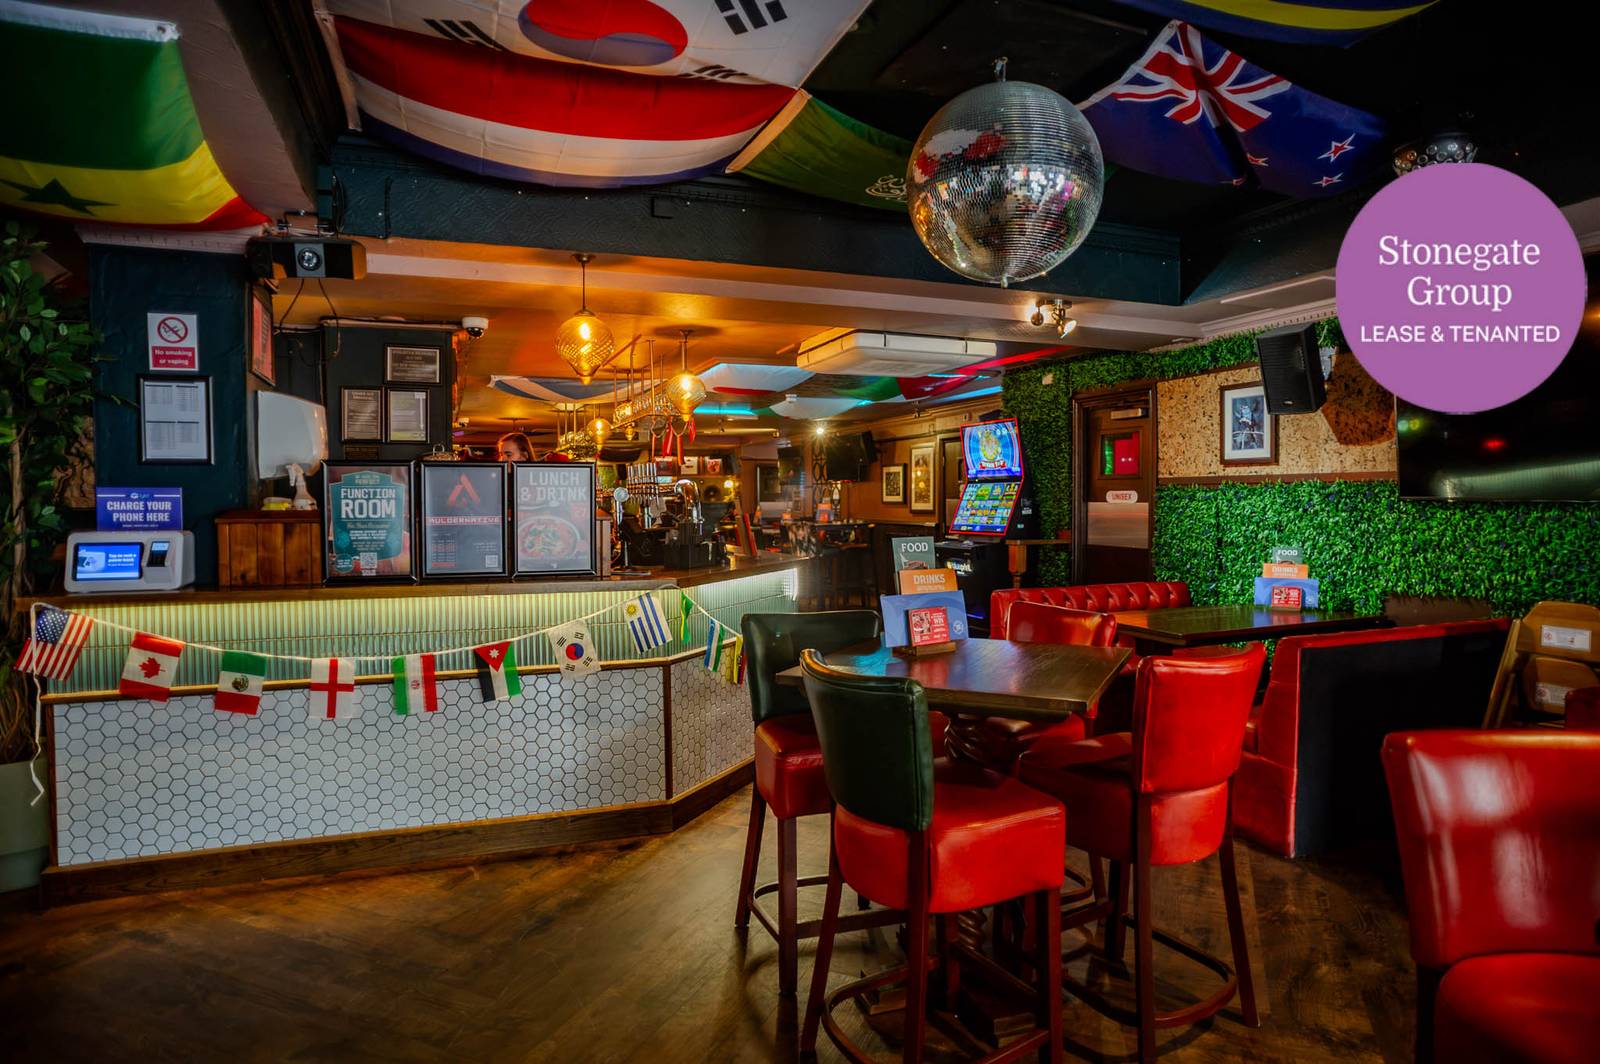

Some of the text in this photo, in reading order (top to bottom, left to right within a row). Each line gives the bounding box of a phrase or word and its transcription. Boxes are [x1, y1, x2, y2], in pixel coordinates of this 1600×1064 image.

[529, 471, 579, 486] LUNCH
[340, 488, 396, 499] FUNCTION
[520, 486, 587, 501] & DRINK
[106, 501, 172, 511] CHARGE YOUR
[340, 499, 396, 519] ROOM
[112, 512, 171, 522] PHONE HERE
[901, 542, 929, 553] FOOD
